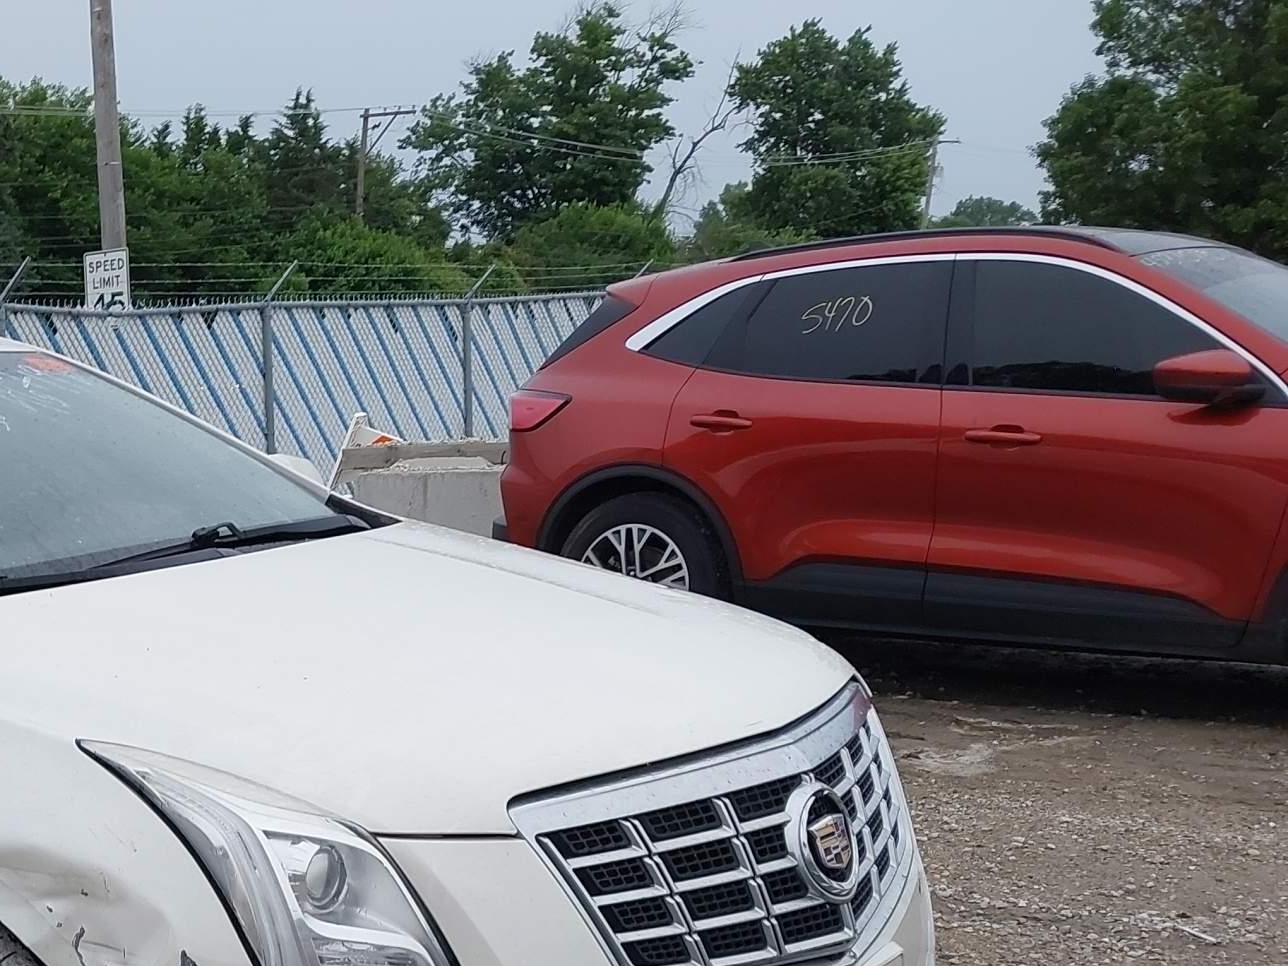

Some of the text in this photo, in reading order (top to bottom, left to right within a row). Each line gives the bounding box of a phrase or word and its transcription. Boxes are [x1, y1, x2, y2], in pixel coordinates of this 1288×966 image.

[88, 258, 125, 274] SPEED
[92, 275, 121, 290] LIMIT
[801, 295, 873, 334] 5470
